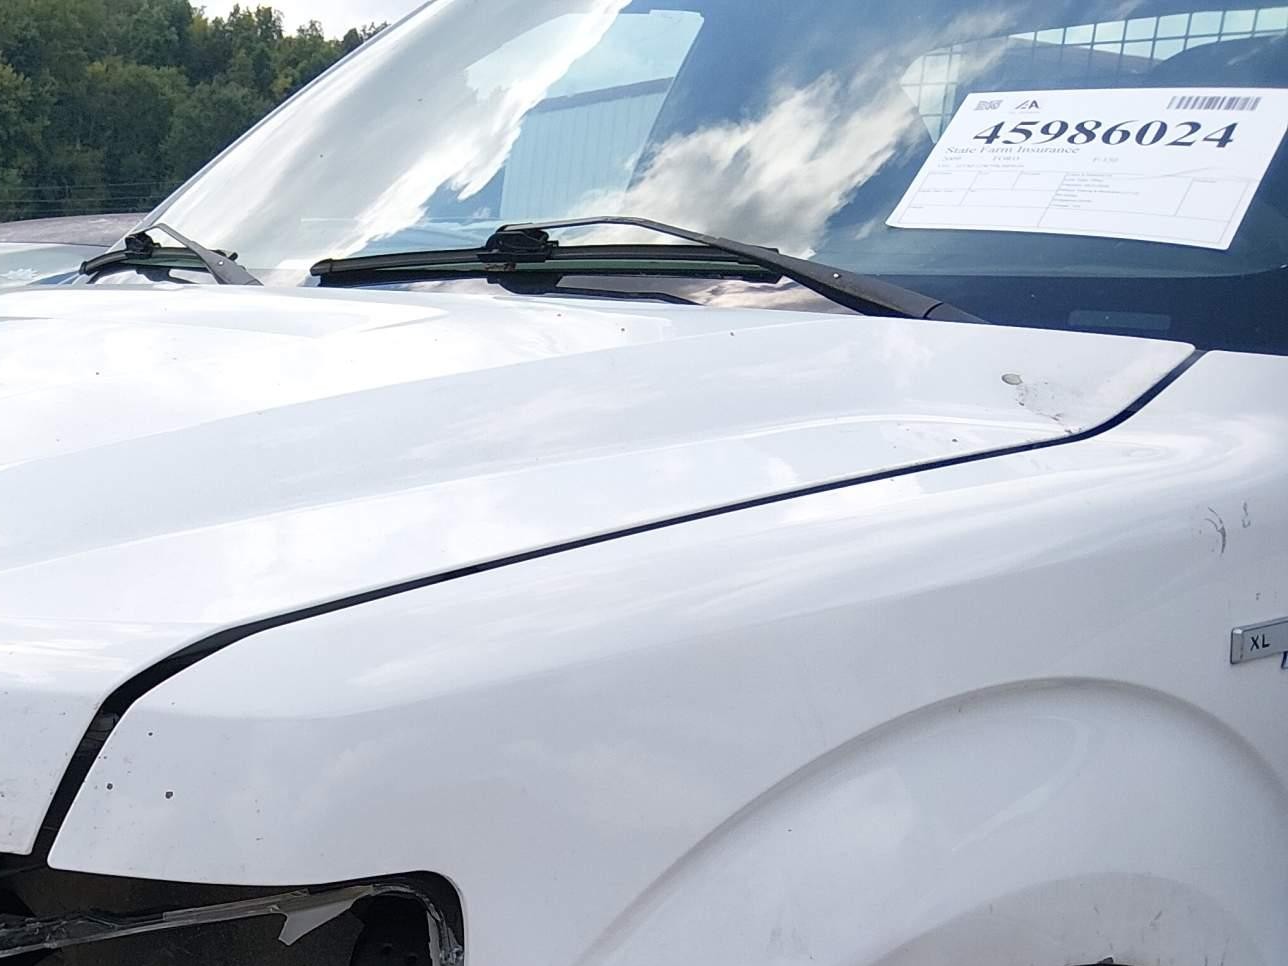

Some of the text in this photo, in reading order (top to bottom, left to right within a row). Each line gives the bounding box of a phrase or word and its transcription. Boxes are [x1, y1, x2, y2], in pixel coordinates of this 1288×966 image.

[972, 119, 1239, 148] 45986024
[945, 145, 1080, 154] State Farm Insurance
[1250, 633, 1272, 651] XL
